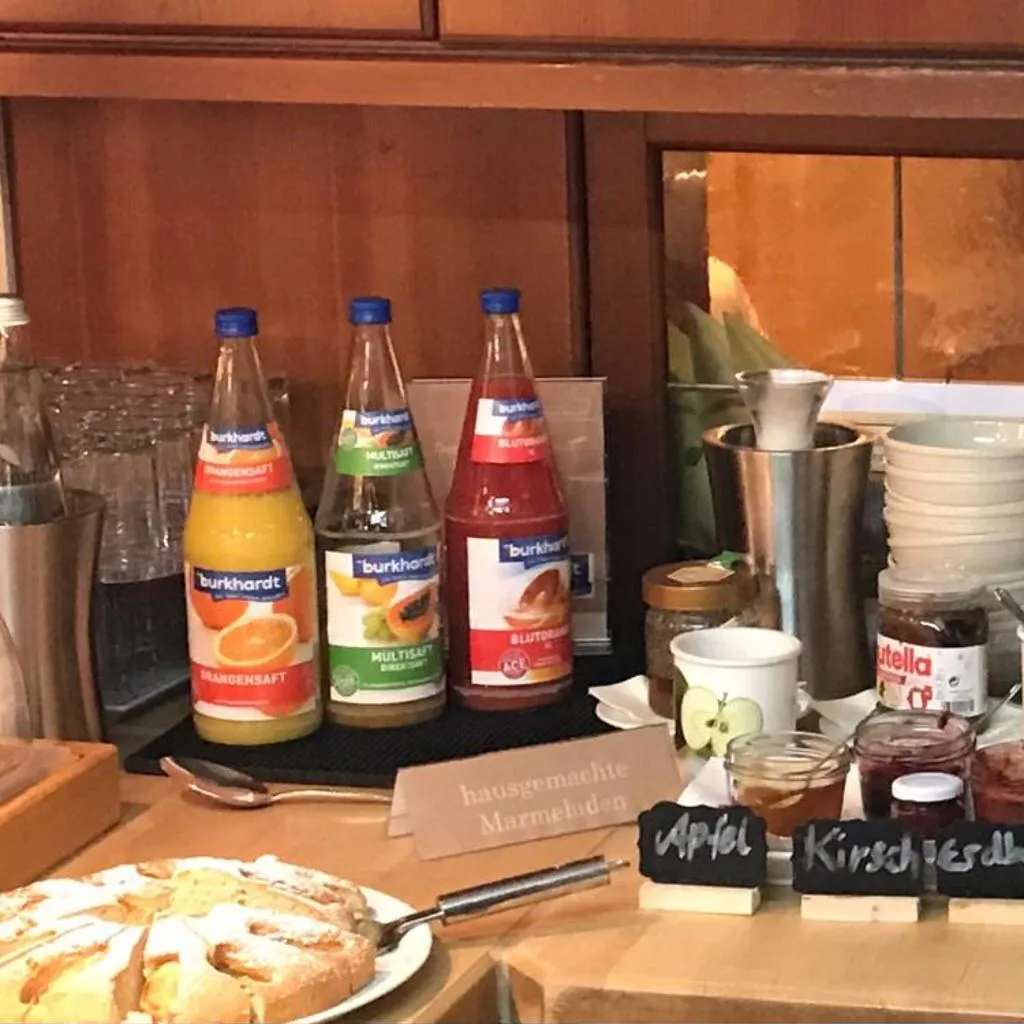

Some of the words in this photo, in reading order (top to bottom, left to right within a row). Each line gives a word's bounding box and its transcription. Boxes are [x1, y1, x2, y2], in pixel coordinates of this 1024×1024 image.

[209, 429, 267, 443] burkhardt
[199, 574, 281, 592] burkhardt
[371, 643, 434, 663] MULTISAFT
[877, 643, 933, 677] utella
[200, 668, 288, 686] ORANGENSAFT
[458, 760, 631, 807] hausgemachte
[478, 794, 628, 837] Marmeladen
[654, 811, 752, 862] Apfel
[803, 823, 920, 880] Kirsch
